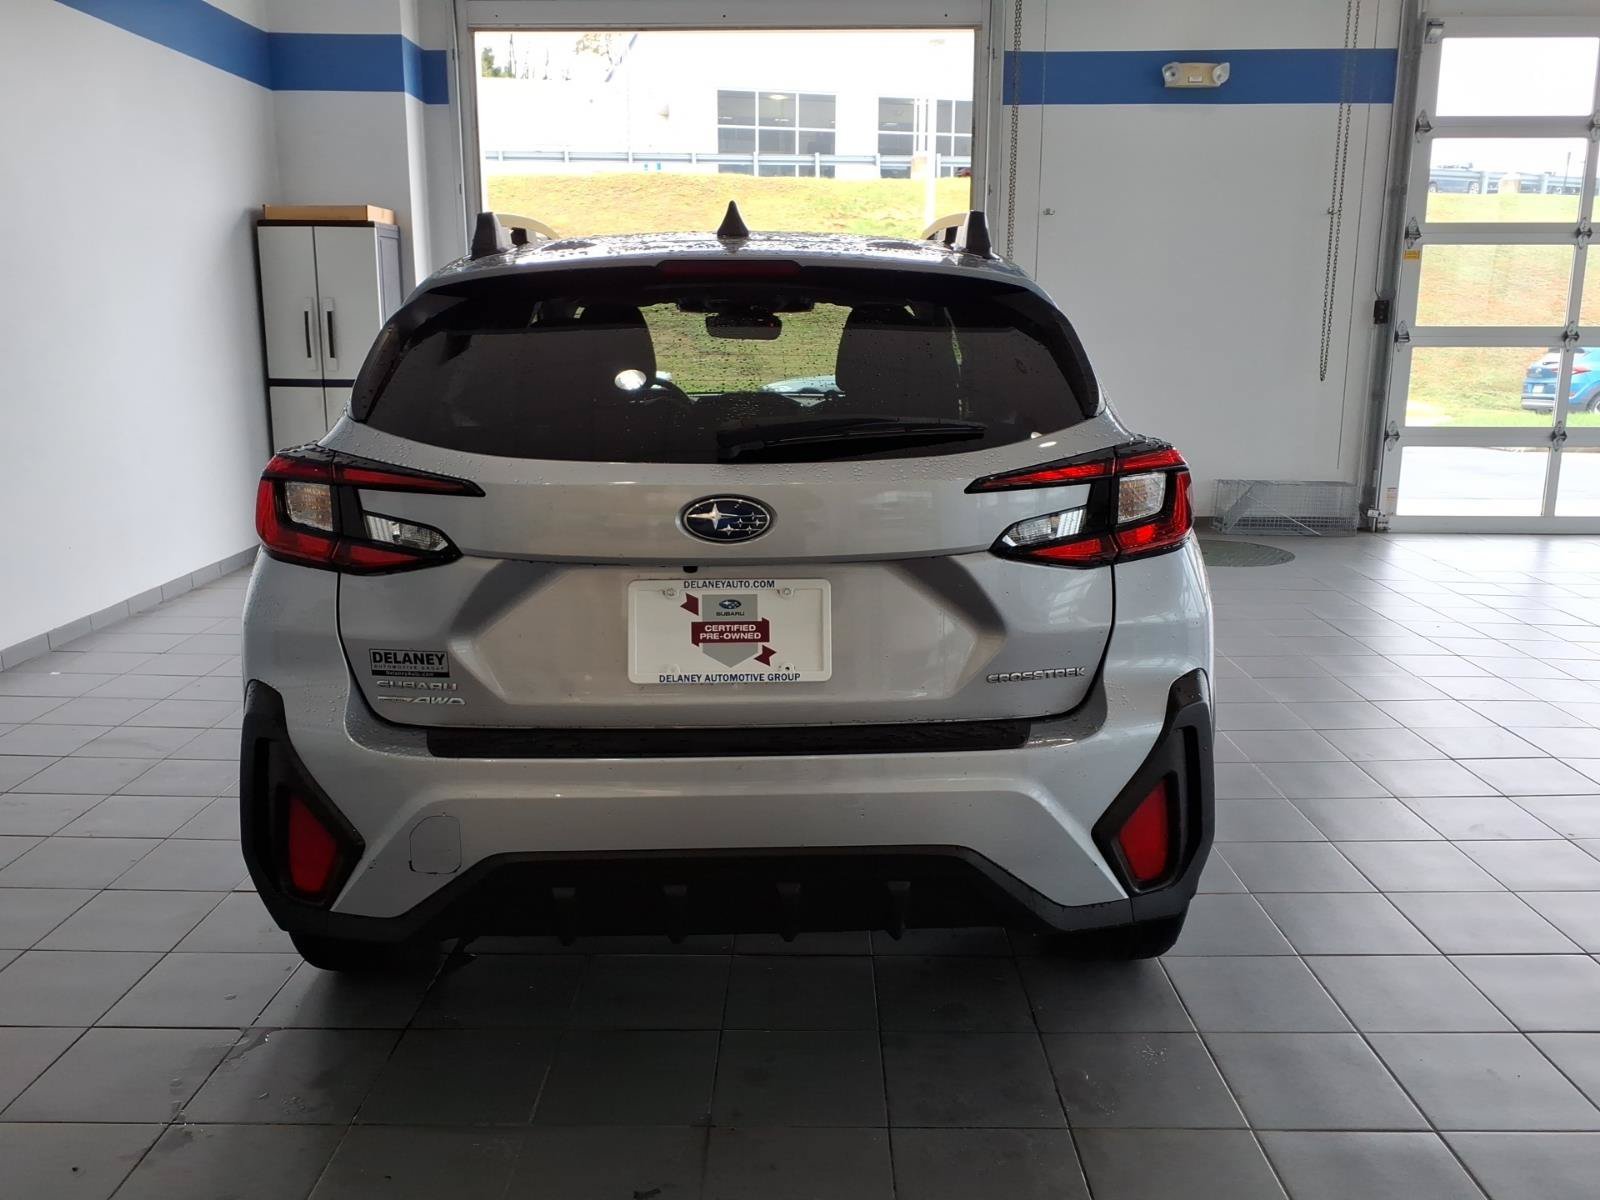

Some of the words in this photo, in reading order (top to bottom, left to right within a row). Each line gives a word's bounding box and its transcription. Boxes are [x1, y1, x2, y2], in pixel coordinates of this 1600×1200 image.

[683, 580, 775, 589] DELANEYAUTO.COM
[704, 624, 757, 632] CERTIFIED
[699, 632, 762, 640] PRE-OWNED
[371, 651, 445, 666] DELANEY
[659, 674, 702, 683] DELANEY
[704, 673, 764, 682] AUTOMOTIVE
[767, 673, 801, 681] GROUP
[986, 667, 1085, 684] CROSSTREK
[377, 680, 458, 691] SUBARU
[412, 696, 466, 705] AWD
